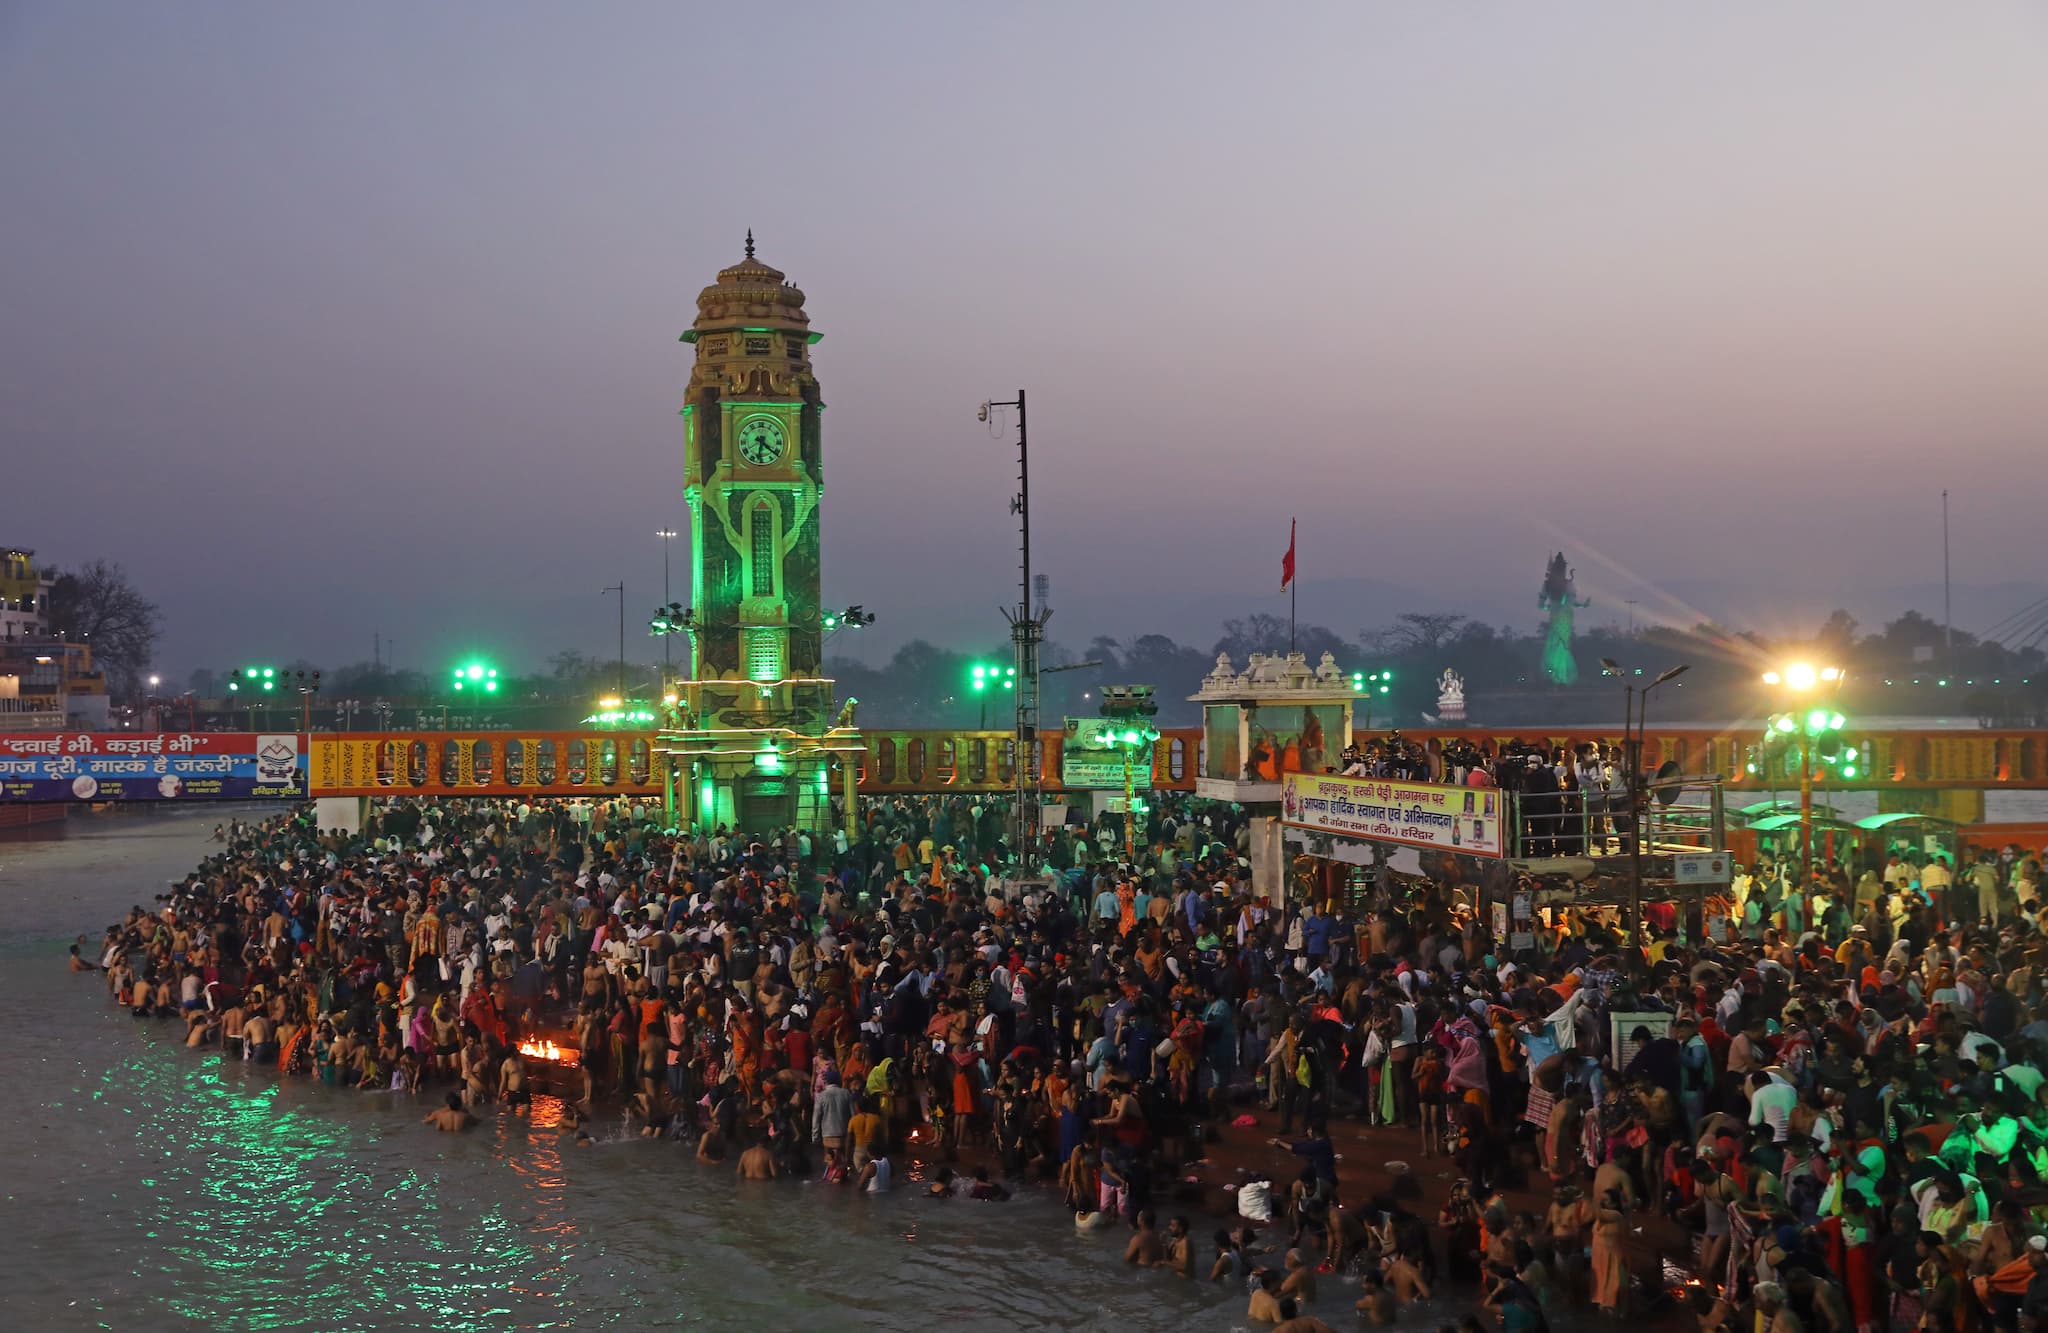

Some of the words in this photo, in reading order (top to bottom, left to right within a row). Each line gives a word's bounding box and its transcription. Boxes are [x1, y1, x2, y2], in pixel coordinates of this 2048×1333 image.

[67, 734, 98, 754] भी,
[105, 734, 163, 758] कड़ाई
[43, 755, 83, 780] दूरी,
[90, 760, 148, 774] मास्क
[152, 755, 169, 774] है
[1394, 790, 1429, 804] आगमन
[1432, 793, 1445, 806] पर
[1304, 798, 1329, 813] आपका
[1330, 796, 1356, 815] हार्दिक
[1358, 804, 1385, 820] स्वागत
[1388, 802, 1402, 823] एवं
[1403, 805, 1452, 830] अभिनन्दन
[1319, 816, 1329, 825] श्री
[1330, 817, 1348, 829] गंगा
[1350, 822, 1368, 832] सभा
[1401, 827, 1434, 841] हरिद्वार
